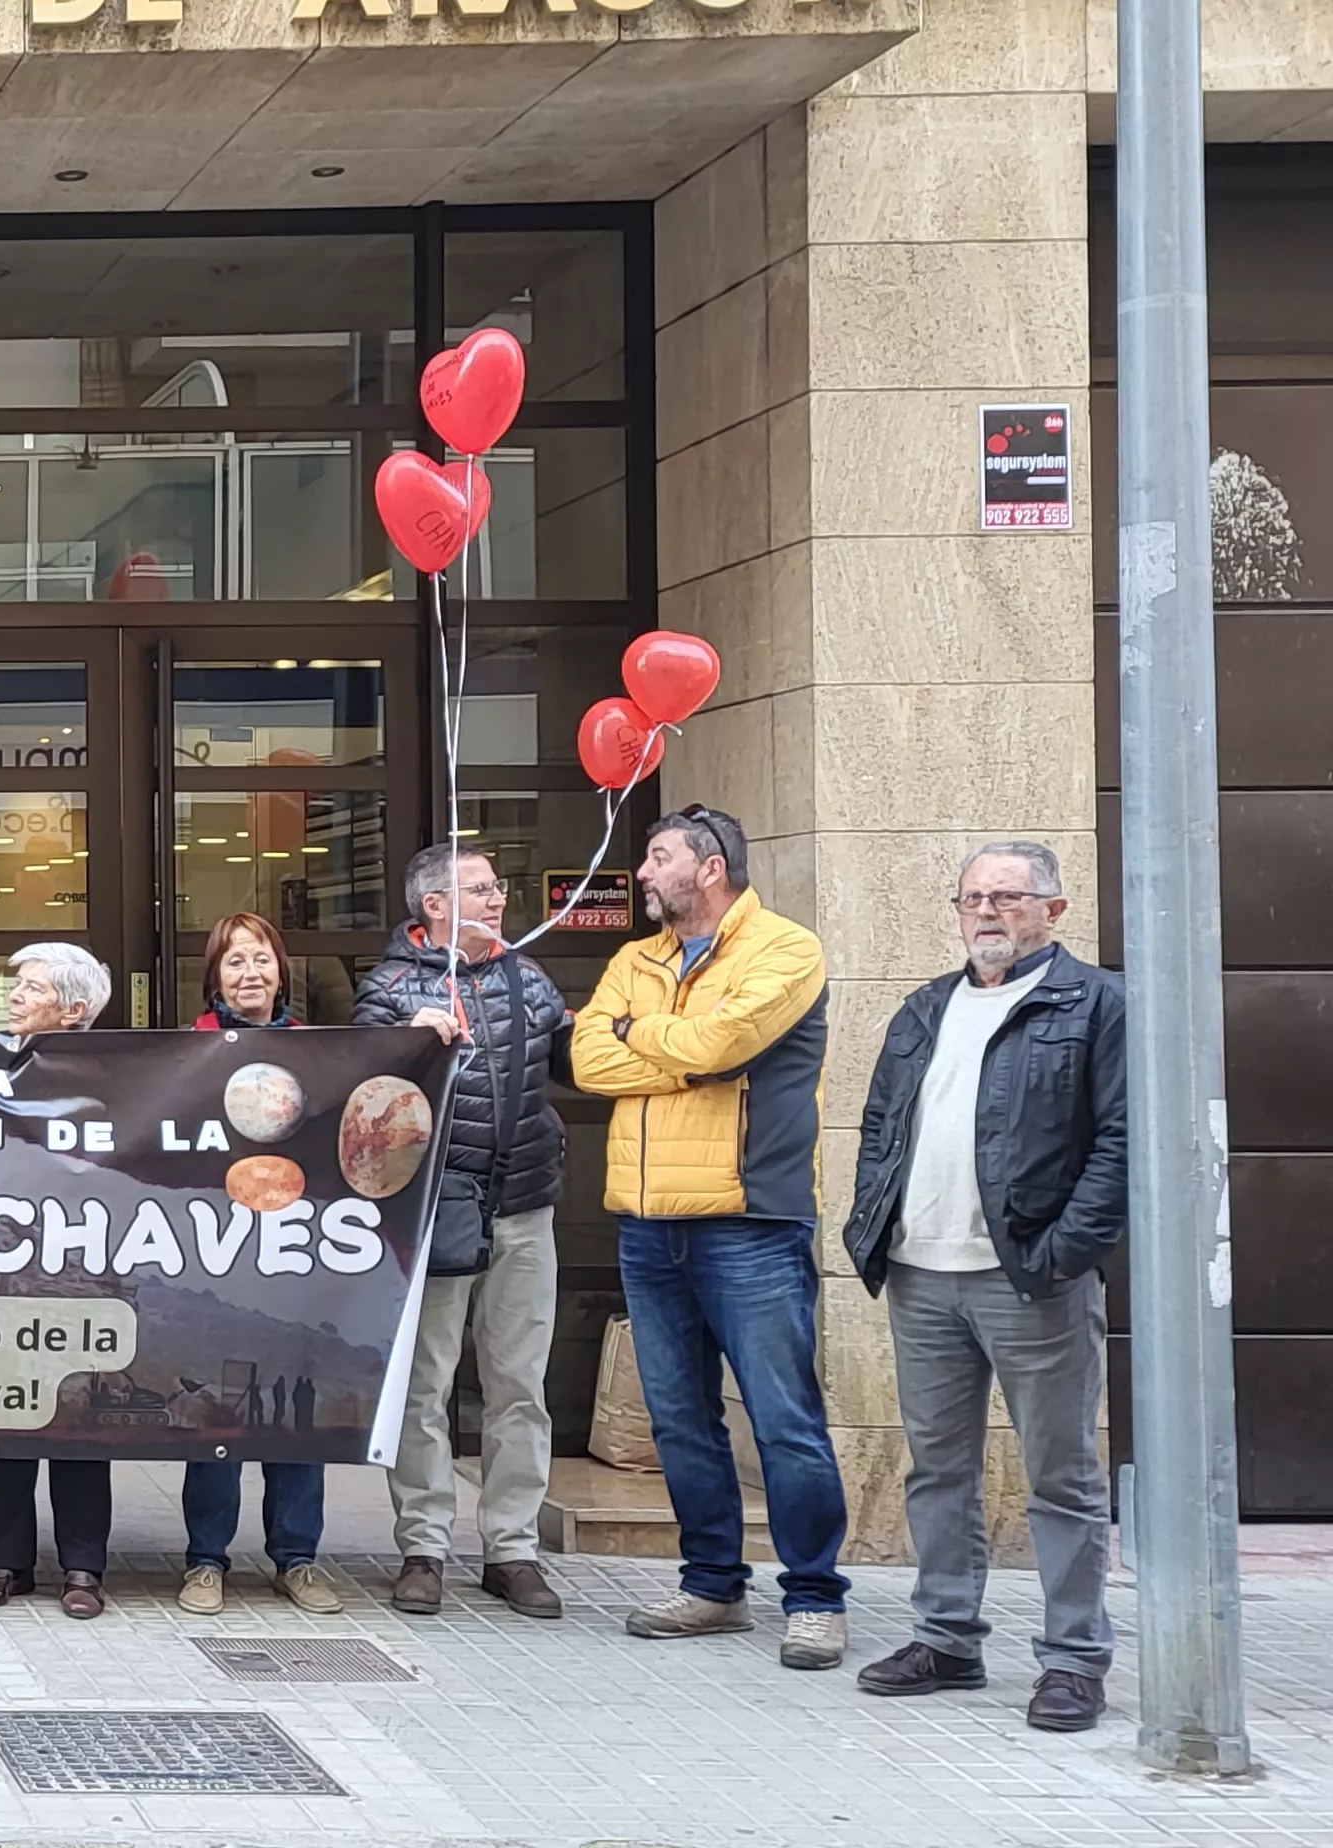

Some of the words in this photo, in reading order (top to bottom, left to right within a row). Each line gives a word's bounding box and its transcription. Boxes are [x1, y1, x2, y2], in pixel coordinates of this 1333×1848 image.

[987, 510, 1011, 524] 902
[1015, 509, 1040, 524] 922
[47, 1120, 115, 1151] DE
[160, 1119, 232, 1151] LA
[15, 1317, 68, 1352] de
[82, 1319, 119, 1353] la
